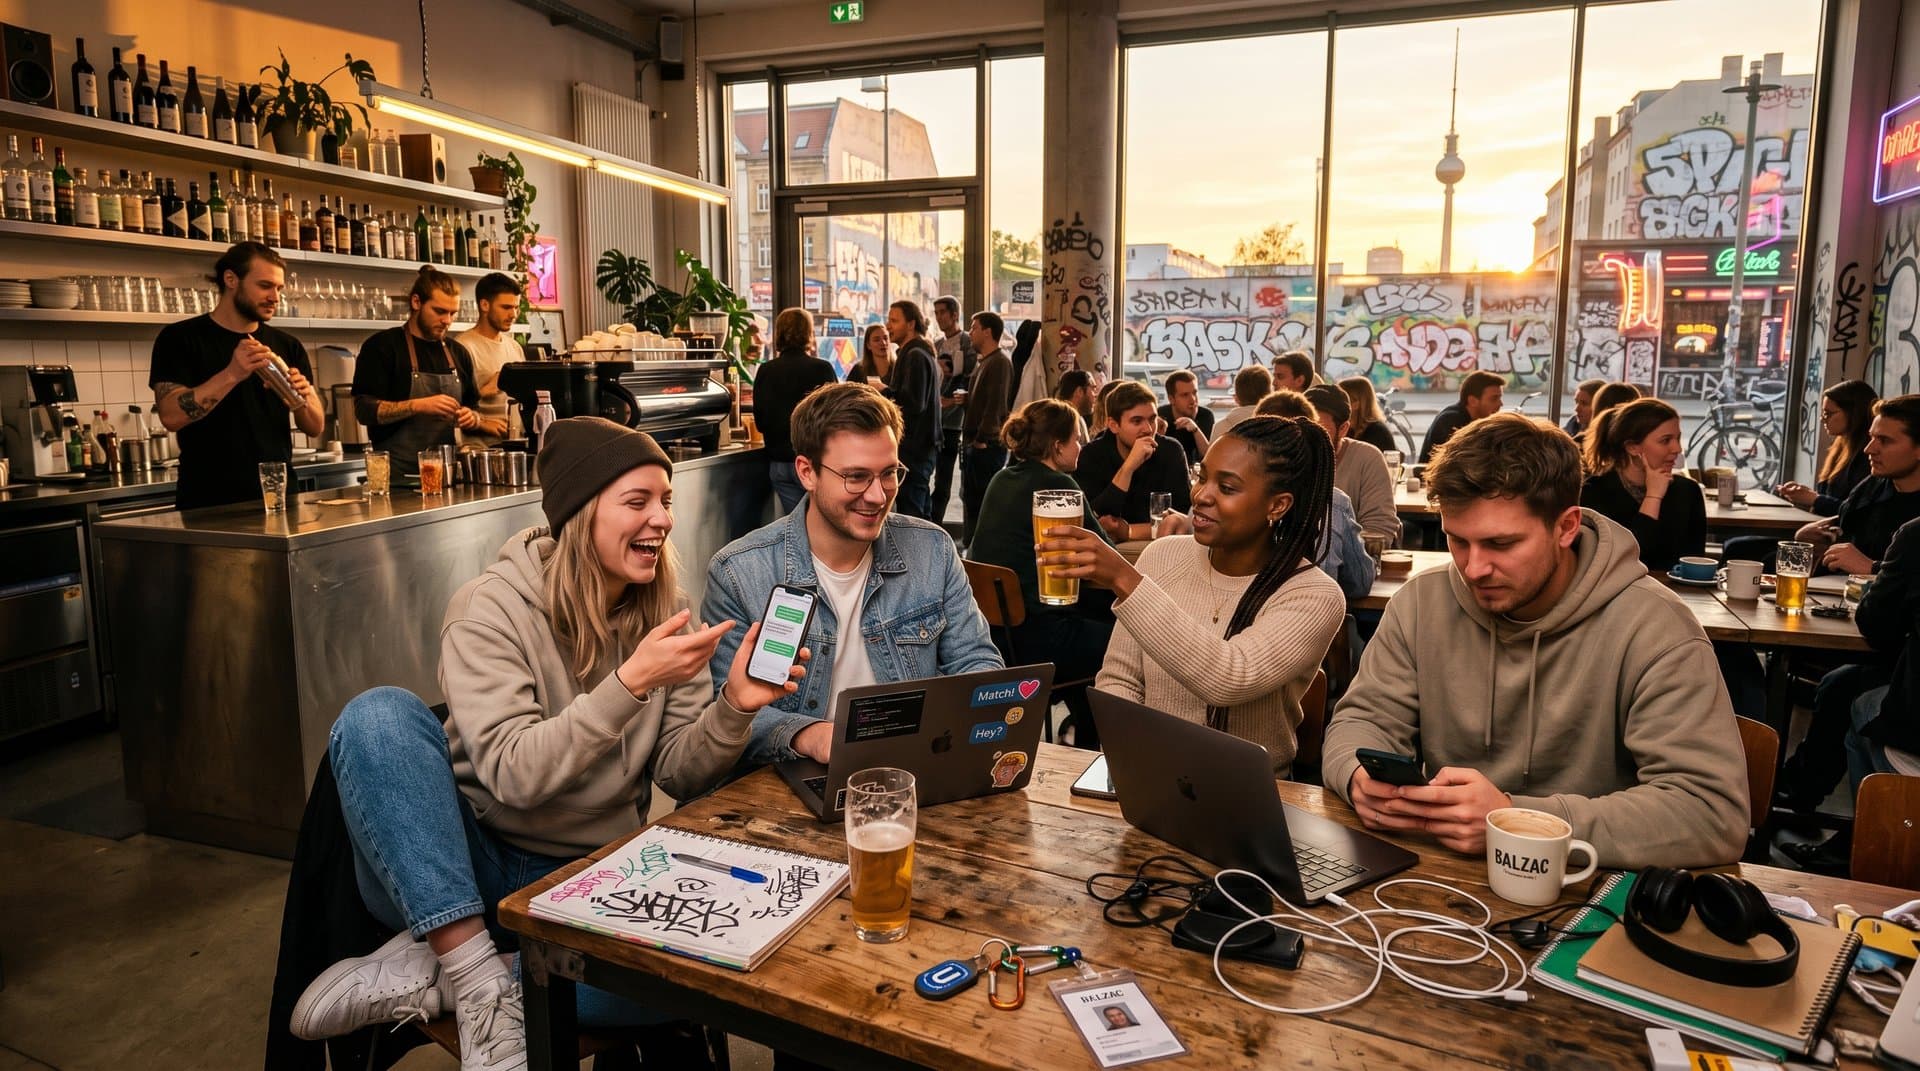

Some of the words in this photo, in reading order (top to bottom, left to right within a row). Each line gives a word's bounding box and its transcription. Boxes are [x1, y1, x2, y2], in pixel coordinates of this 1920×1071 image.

[977, 687, 1016, 702] Match!
[975, 726, 1004, 740] Hey?
[1495, 848, 1550, 874] BALZAC
[931, 965, 961, 984] U
